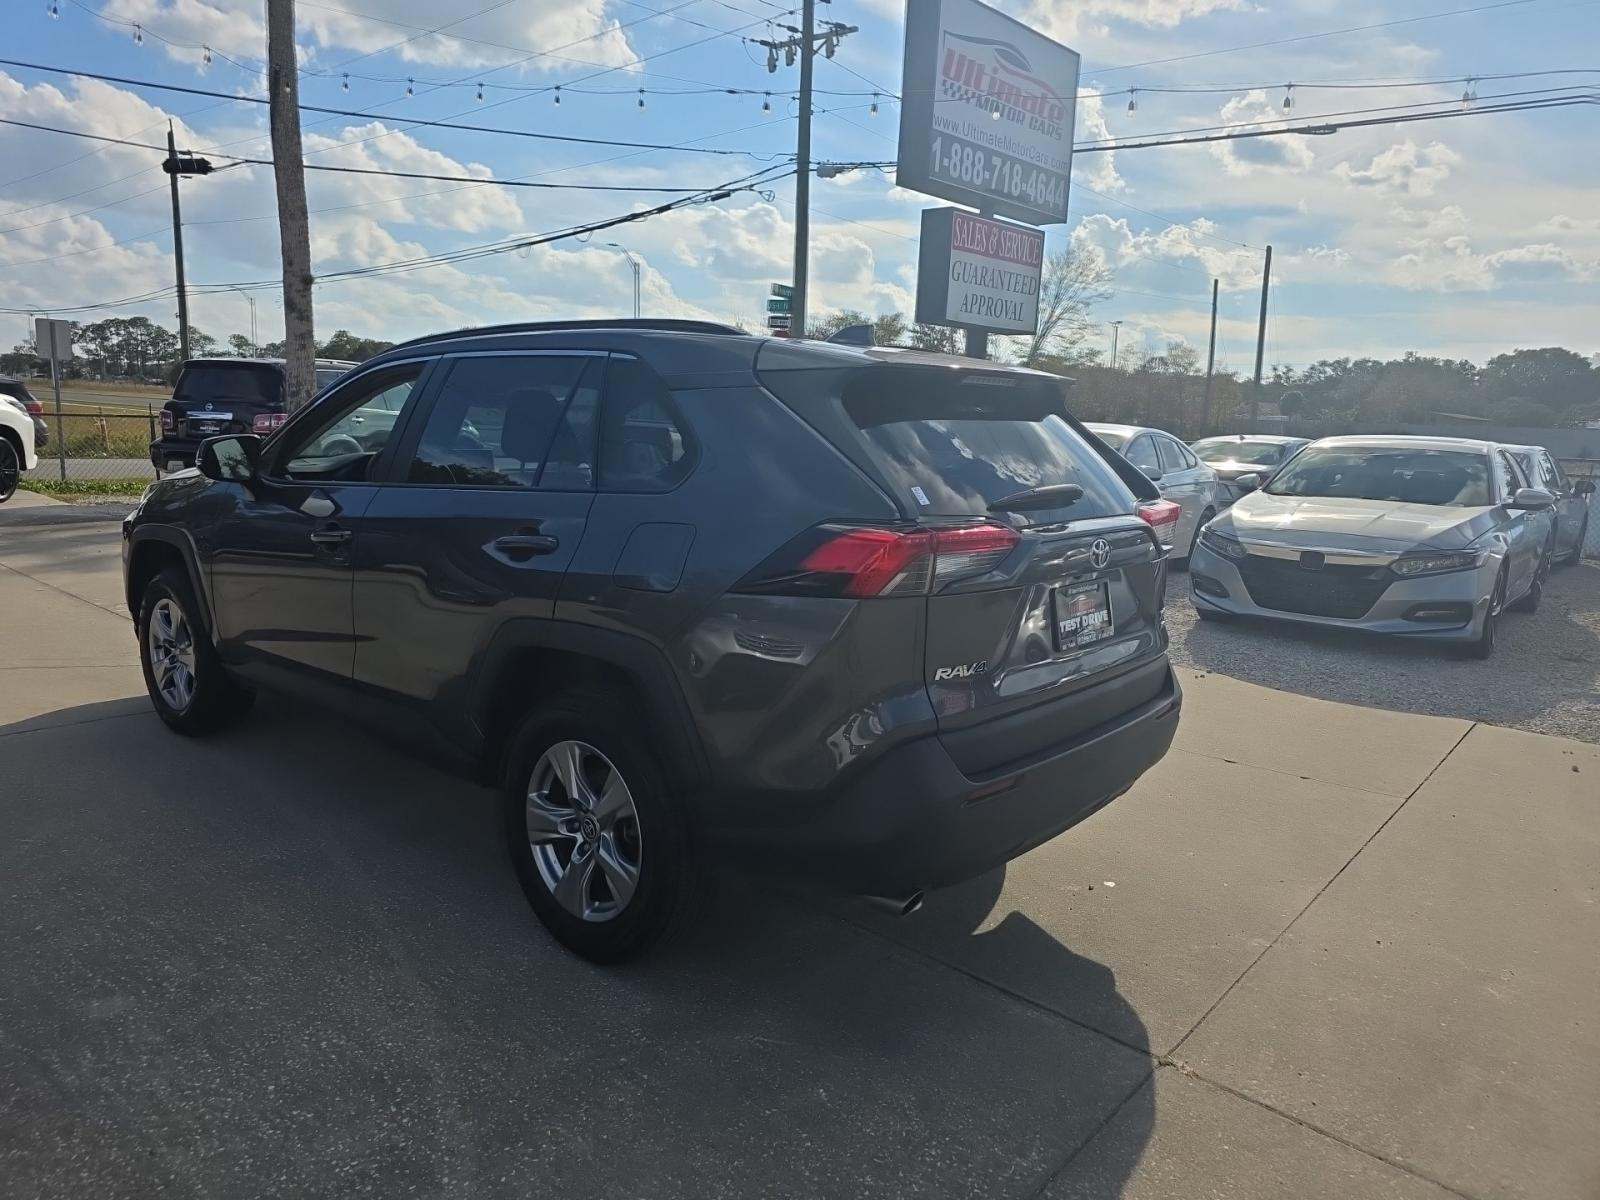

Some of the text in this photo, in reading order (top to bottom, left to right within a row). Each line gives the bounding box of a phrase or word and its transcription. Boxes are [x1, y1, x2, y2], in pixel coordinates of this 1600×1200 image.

[1029, 116, 1064, 141] CARS
[932, 136, 1067, 208] 1-888-718-4644
[953, 217, 1041, 265] SALES & SERVICE
[951, 260, 1038, 296] GUARANTEED
[959, 292, 1026, 322] APPROVAL
[1059, 609, 1109, 633] TEST DRIVE
[934, 660, 987, 681] RAV4
